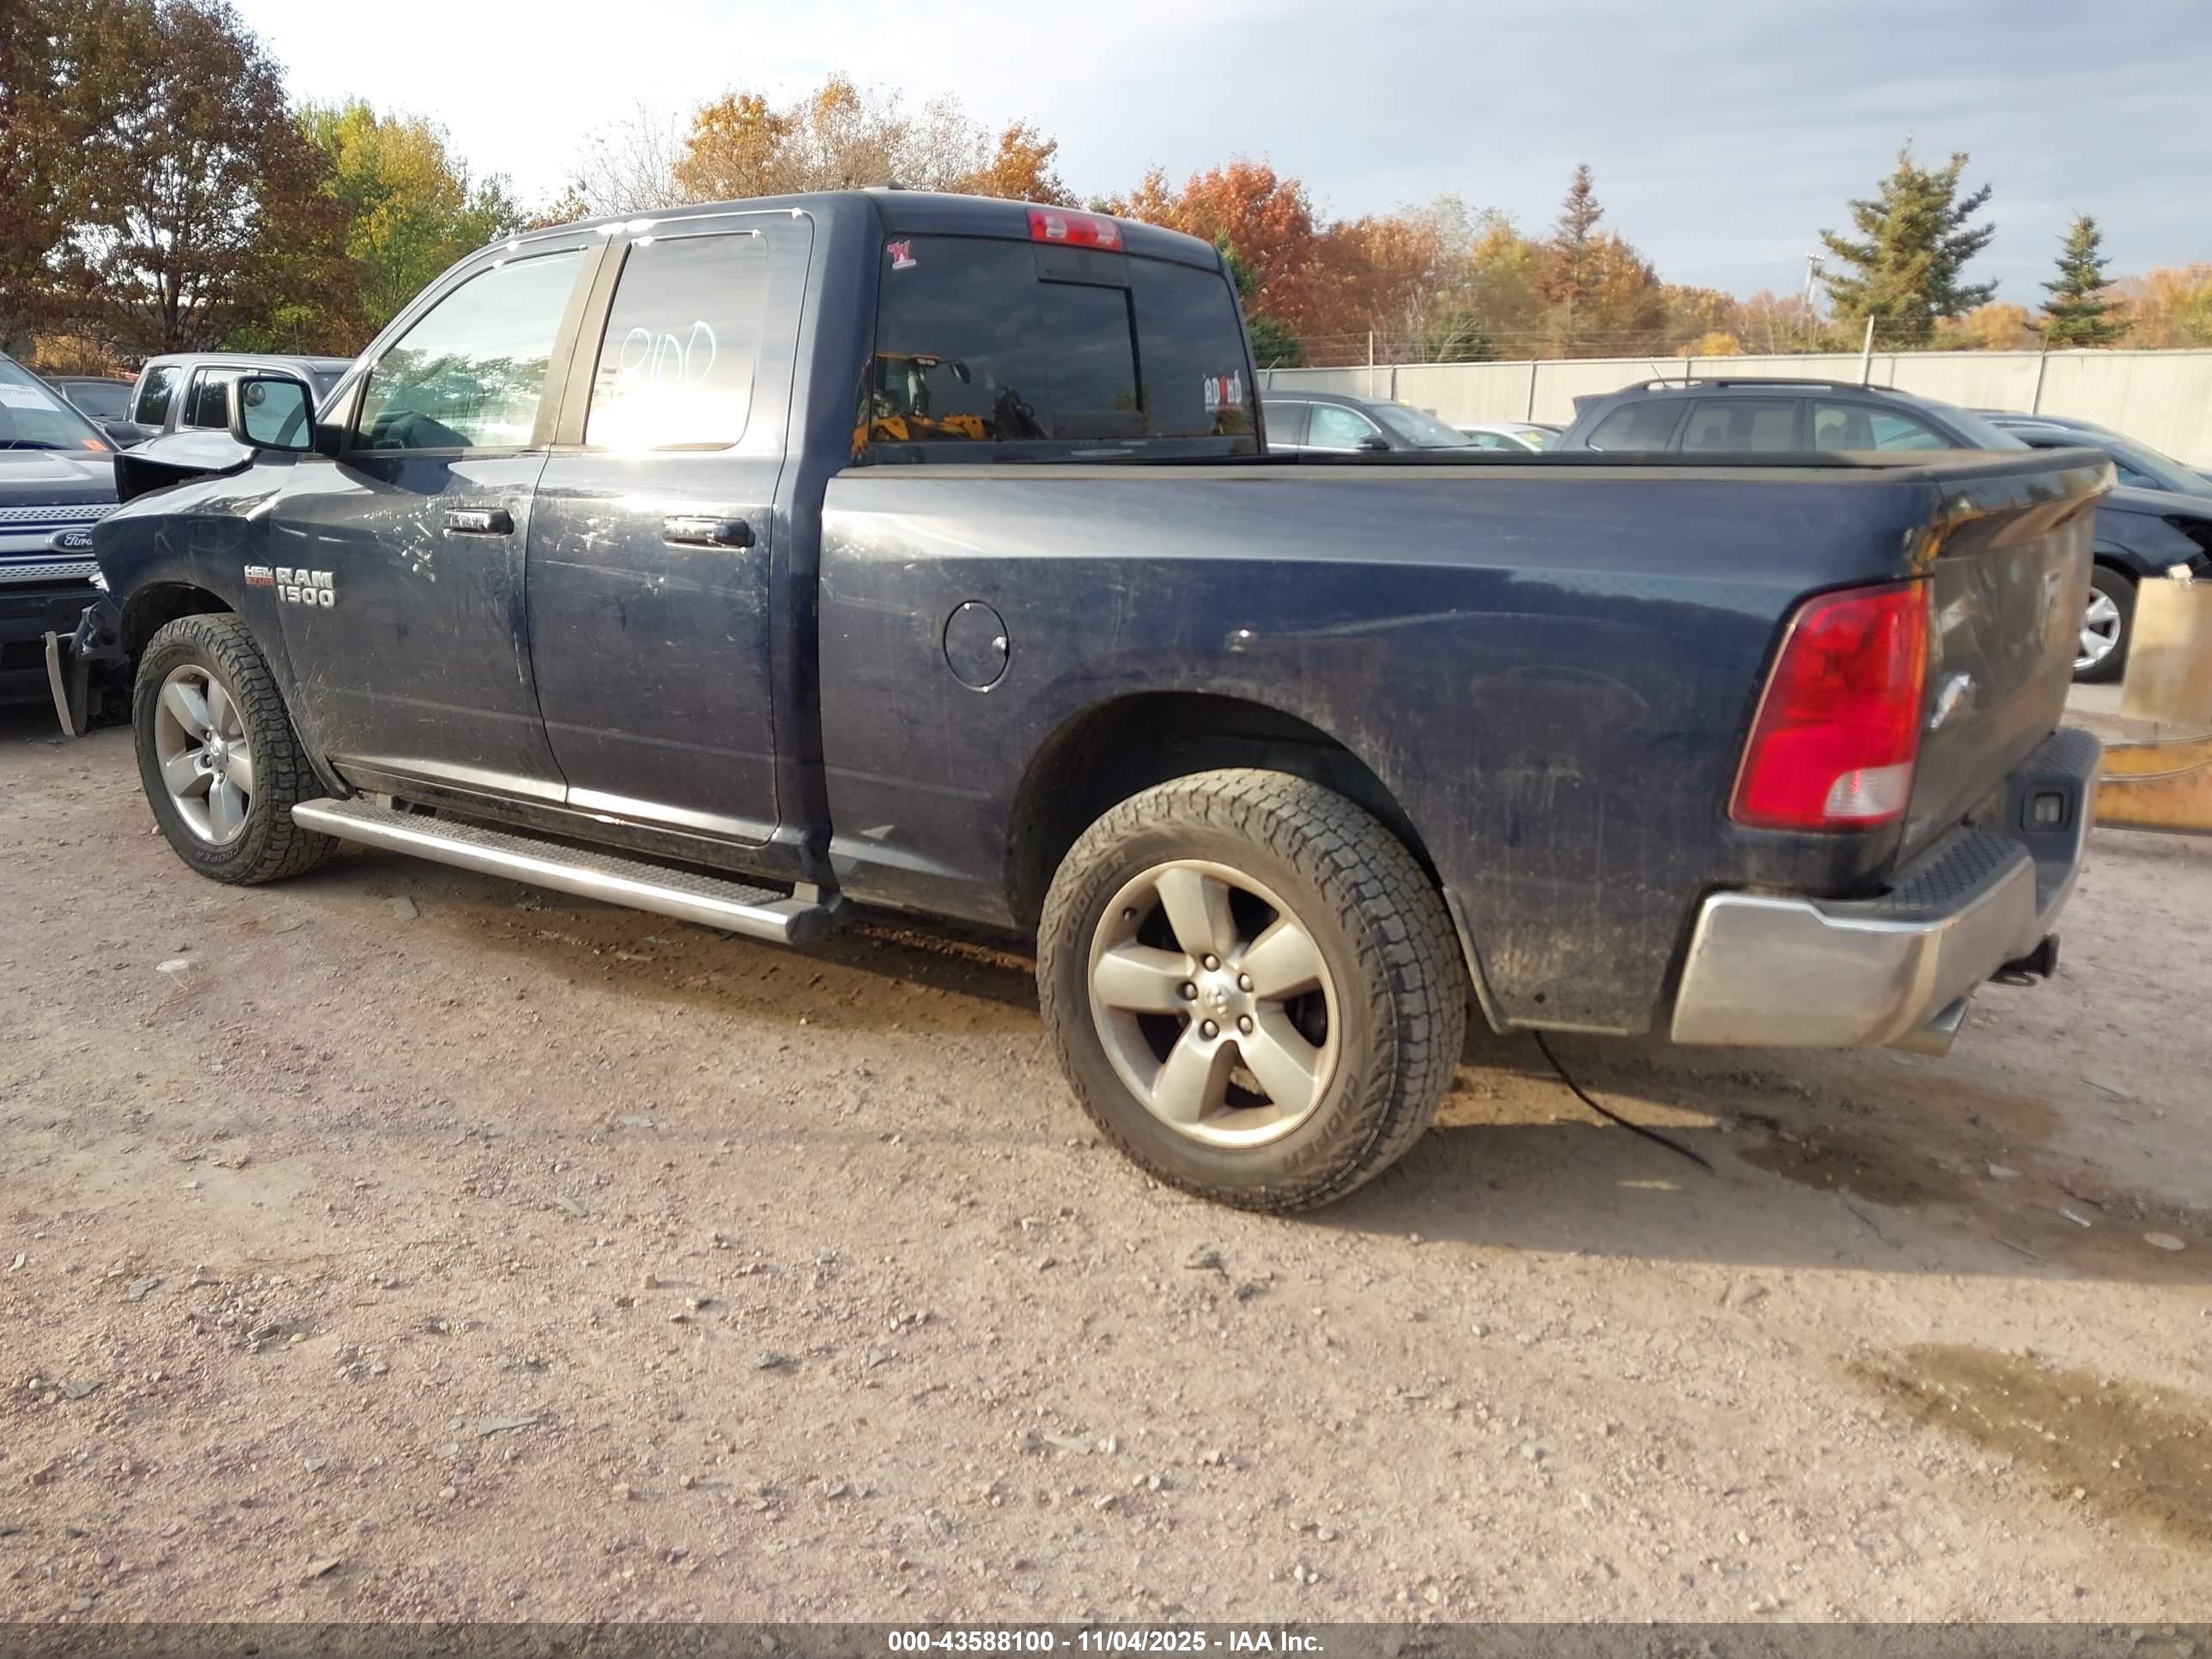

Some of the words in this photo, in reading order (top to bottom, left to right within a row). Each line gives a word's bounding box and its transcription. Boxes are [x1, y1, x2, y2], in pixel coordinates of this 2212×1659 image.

[244, 566, 275, 579] HEM
[276, 567, 333, 589] RAM
[277, 585, 336, 607] 1500
[1066, 850, 1127, 949] COOPER
